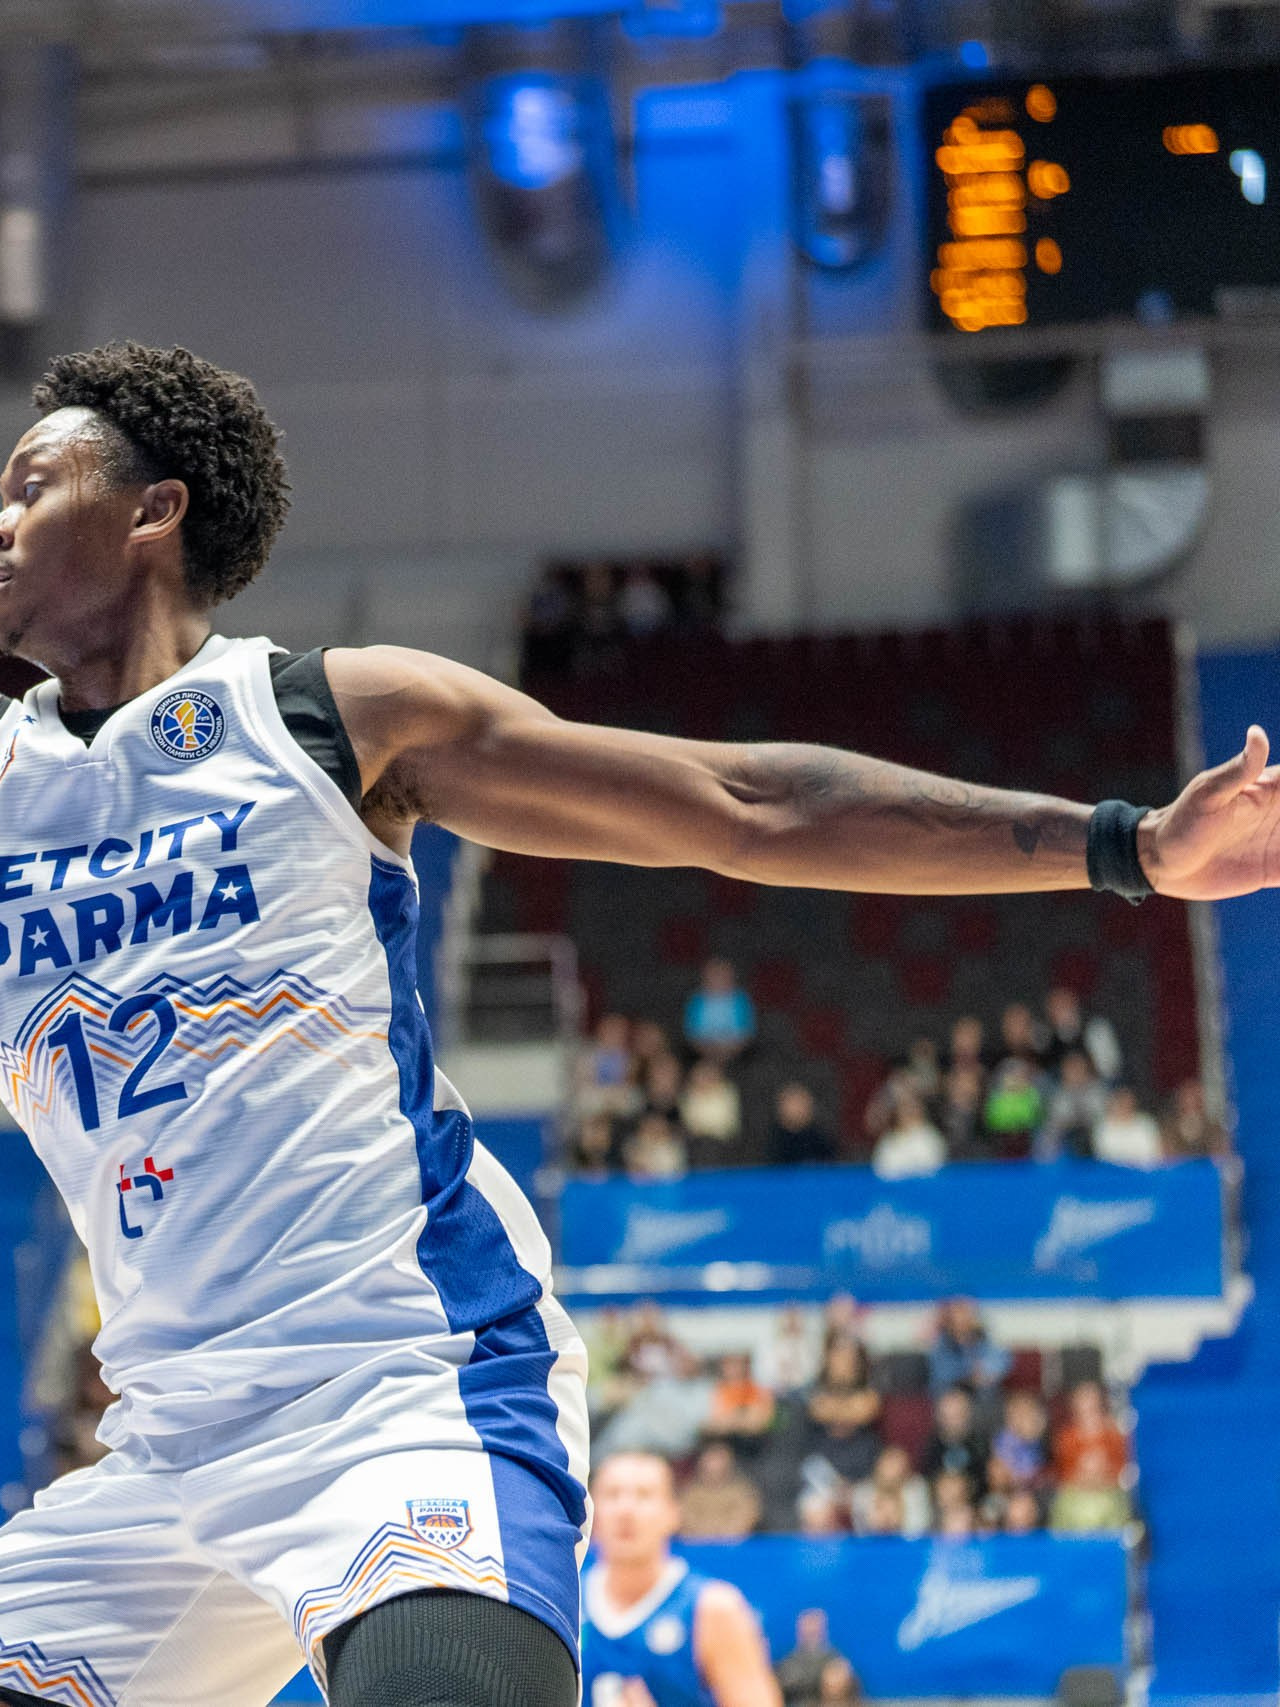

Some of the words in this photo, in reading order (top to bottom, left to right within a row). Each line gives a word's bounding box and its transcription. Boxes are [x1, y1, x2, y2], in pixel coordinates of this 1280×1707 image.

[182, 692, 201, 700] ЛИГА
[202, 695, 215, 708] ВТБ
[164, 746, 195, 759] ПАМЯТИ
[48, 993, 188, 1132] 12
